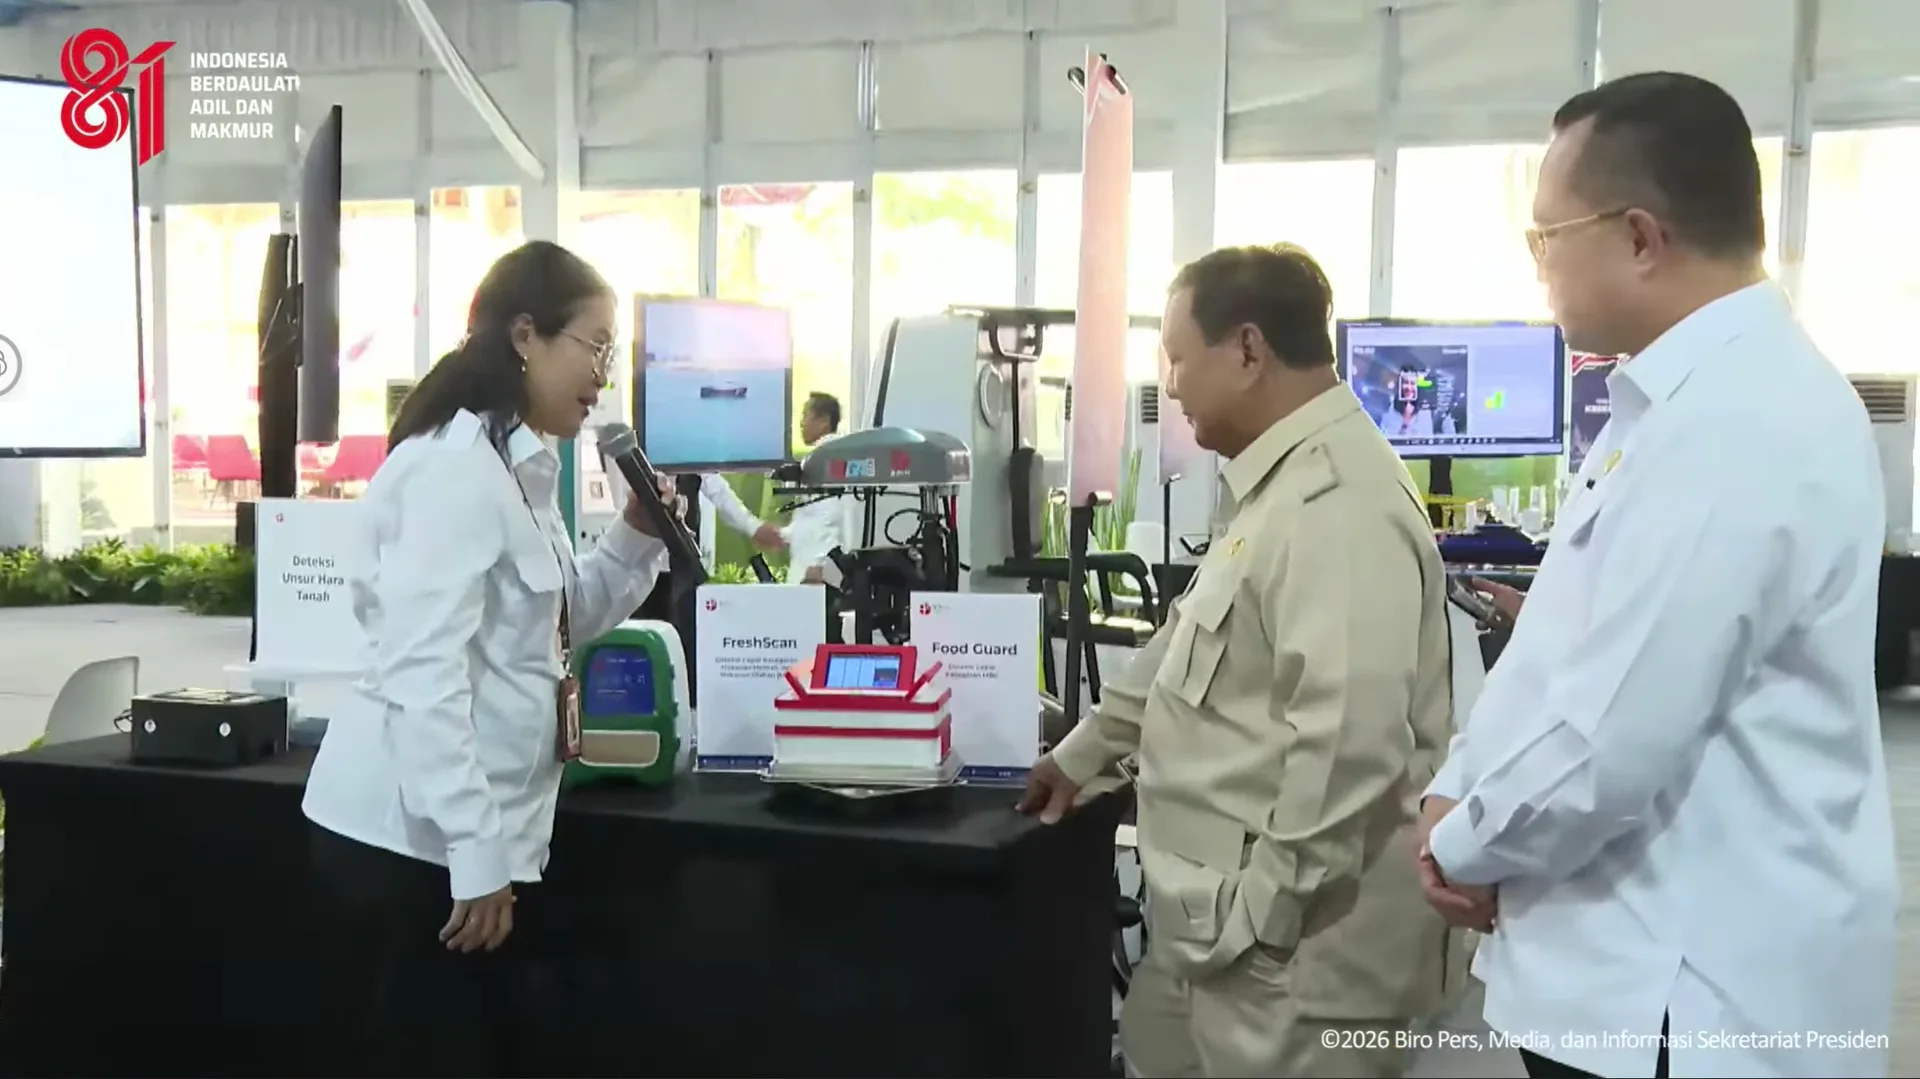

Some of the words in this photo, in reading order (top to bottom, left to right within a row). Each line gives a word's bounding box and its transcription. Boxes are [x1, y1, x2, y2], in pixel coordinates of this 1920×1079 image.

[292, 555, 335, 568] Deteksi
[282, 572, 315, 584] Unsur
[318, 573, 345, 586] Hara
[297, 589, 330, 602] Tanah
[723, 636, 797, 649] FreshScan
[932, 642, 968, 655] Food
[973, 643, 1017, 656] Guard
